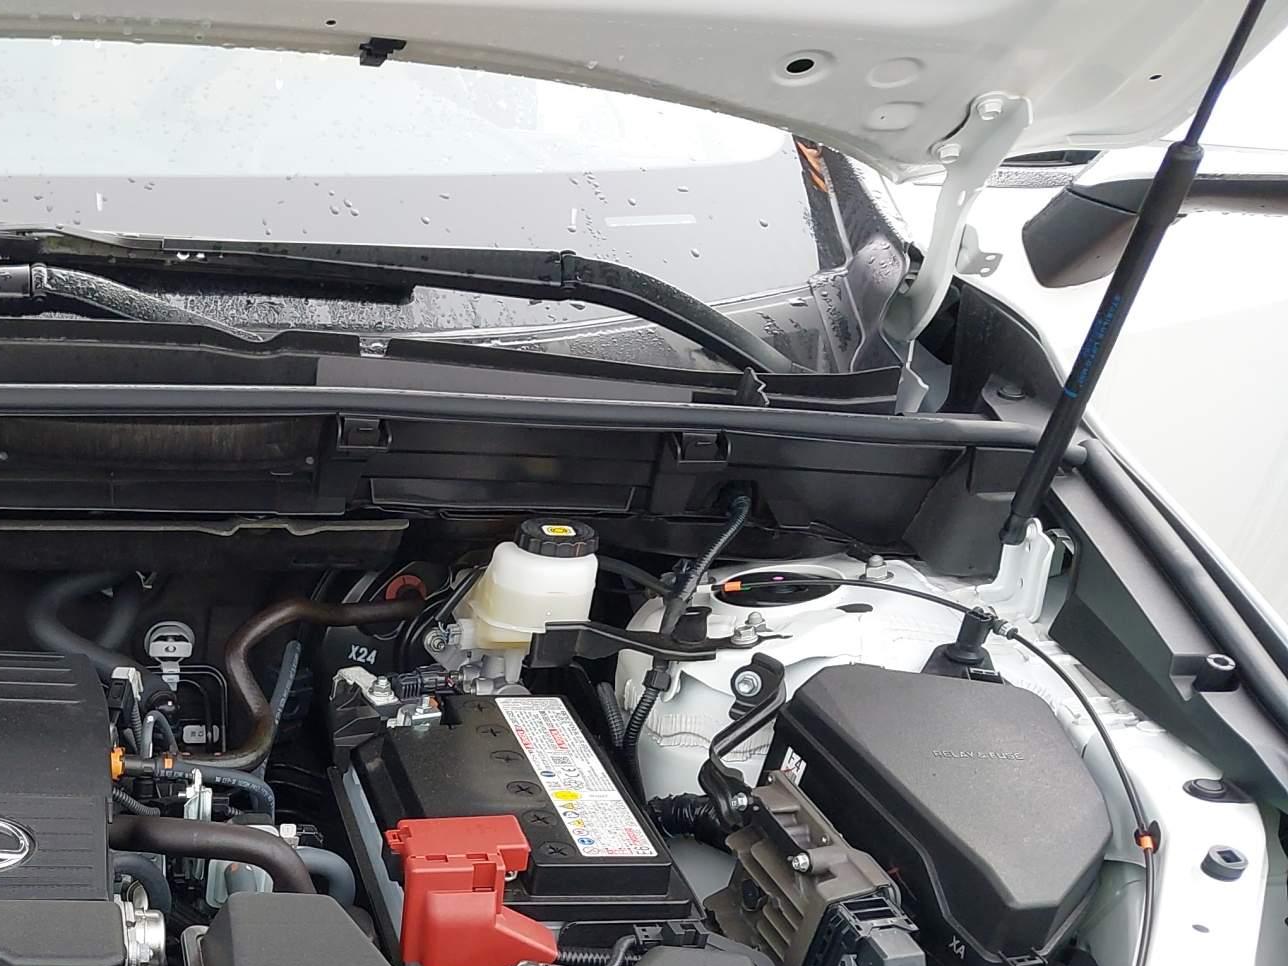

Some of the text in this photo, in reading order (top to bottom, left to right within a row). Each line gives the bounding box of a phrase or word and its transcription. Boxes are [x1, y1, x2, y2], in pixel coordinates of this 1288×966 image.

[348, 644, 377, 665] X24
[931, 750, 974, 760] RELAY
[948, 935, 965, 960] XA
